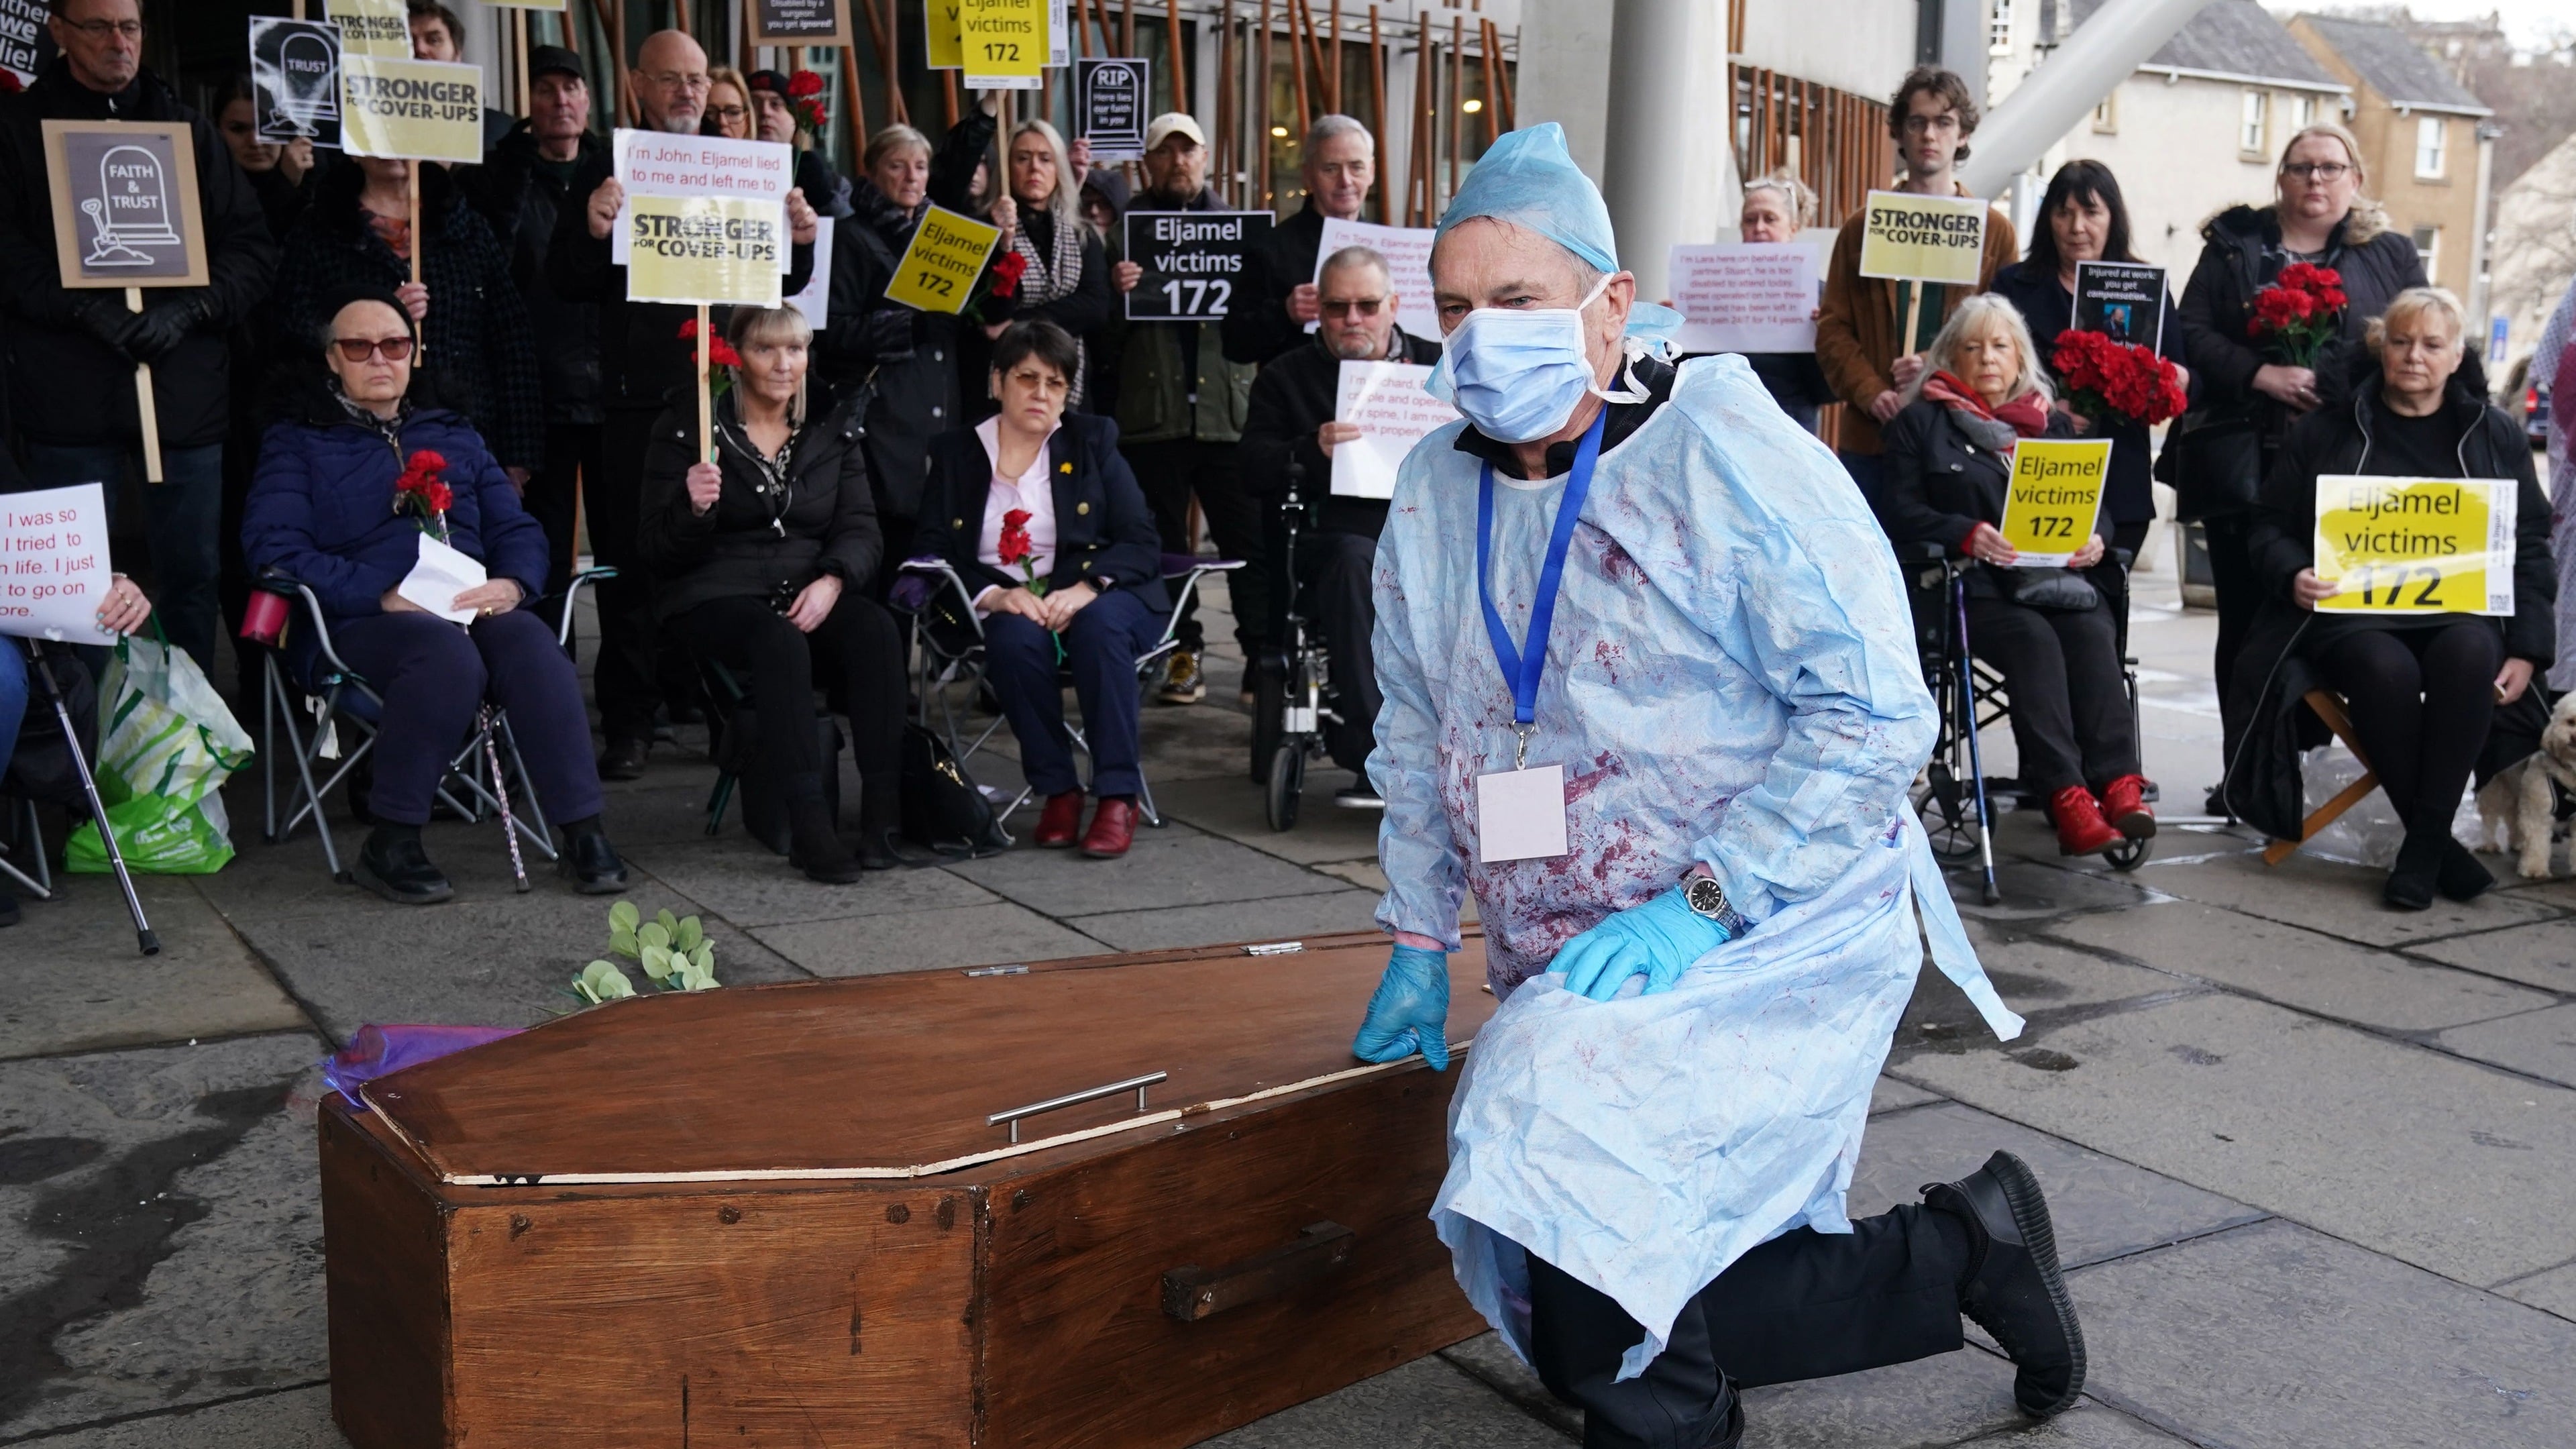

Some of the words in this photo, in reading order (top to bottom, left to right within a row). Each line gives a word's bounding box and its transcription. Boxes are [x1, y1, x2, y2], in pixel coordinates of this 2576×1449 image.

[0, 13, 38, 40] we
[966, 16, 1031, 33] victims
[0, 37, 38, 72] lie!
[983, 44, 1020, 61] 172
[286, 58, 327, 73] TRUST
[1097, 69, 1129, 86] RIP
[346, 74, 477, 105] STRONGER
[370, 100, 478, 123] COVER-UPS
[628, 146, 650, 160] I'm
[655, 147, 696, 164] John.
[702, 151, 753, 169] Eljamel
[757, 155, 780, 170] lied
[109, 164, 154, 178] FAITH
[633, 169, 646, 182] to
[651, 173, 675, 184] me
[680, 172, 707, 186] and
[712, 175, 733, 189] left
[738, 178, 758, 189] me
[763, 180, 775, 192] to
[128, 180, 140, 193] &
[111, 195, 158, 209] TRUST
[635, 214, 774, 242] STRONGER
[1871, 209, 1980, 233] STRONGER
[924, 223, 990, 256] Eljamel
[1155, 217, 1242, 247] Eljamel
[1869, 227, 1885, 235] FOR
[1886, 229, 1979, 249] COVER-UPS
[634, 239, 655, 248] FOR
[657, 240, 775, 260] COVER-UPS
[1751, 254, 1778, 262] behalf
[914, 246, 976, 277] victims
[1154, 250, 1242, 272] victims
[2088, 266, 2120, 278] Injured
[2121, 268, 2131, 278] at
[918, 271, 953, 297] 172
[2104, 281, 2121, 290] you
[2122, 282, 2137, 290] get
[1162, 278, 1232, 315] 172
[1373, 377, 1416, 390] chard.
[1348, 391, 1385, 403] crple
[1388, 394, 1408, 404] and
[1411, 413, 1428, 422] am
[2020, 456, 2102, 481] Eljamel
[2015, 485, 2095, 505] victims
[2349, 487, 2460, 521] Eljamel
[9, 513, 12, 527] I
[19, 512, 53, 527] was
[59, 509, 76, 523] so
[2030, 516, 2074, 537] 172
[5, 537, 9, 551] I
[17, 533, 56, 551] tried
[66, 533, 80, 547] to
[2345, 527, 2457, 555] victims
[16, 559, 47, 574] life.
[56, 558, 59, 572] I
[65, 554, 95, 575] just
[8, 584, 25, 596] to
[33, 584, 56, 599] go
[63, 583, 85, 595] on
[2353, 566, 2443, 605] 172
[0, 606, 34, 616] ore.
